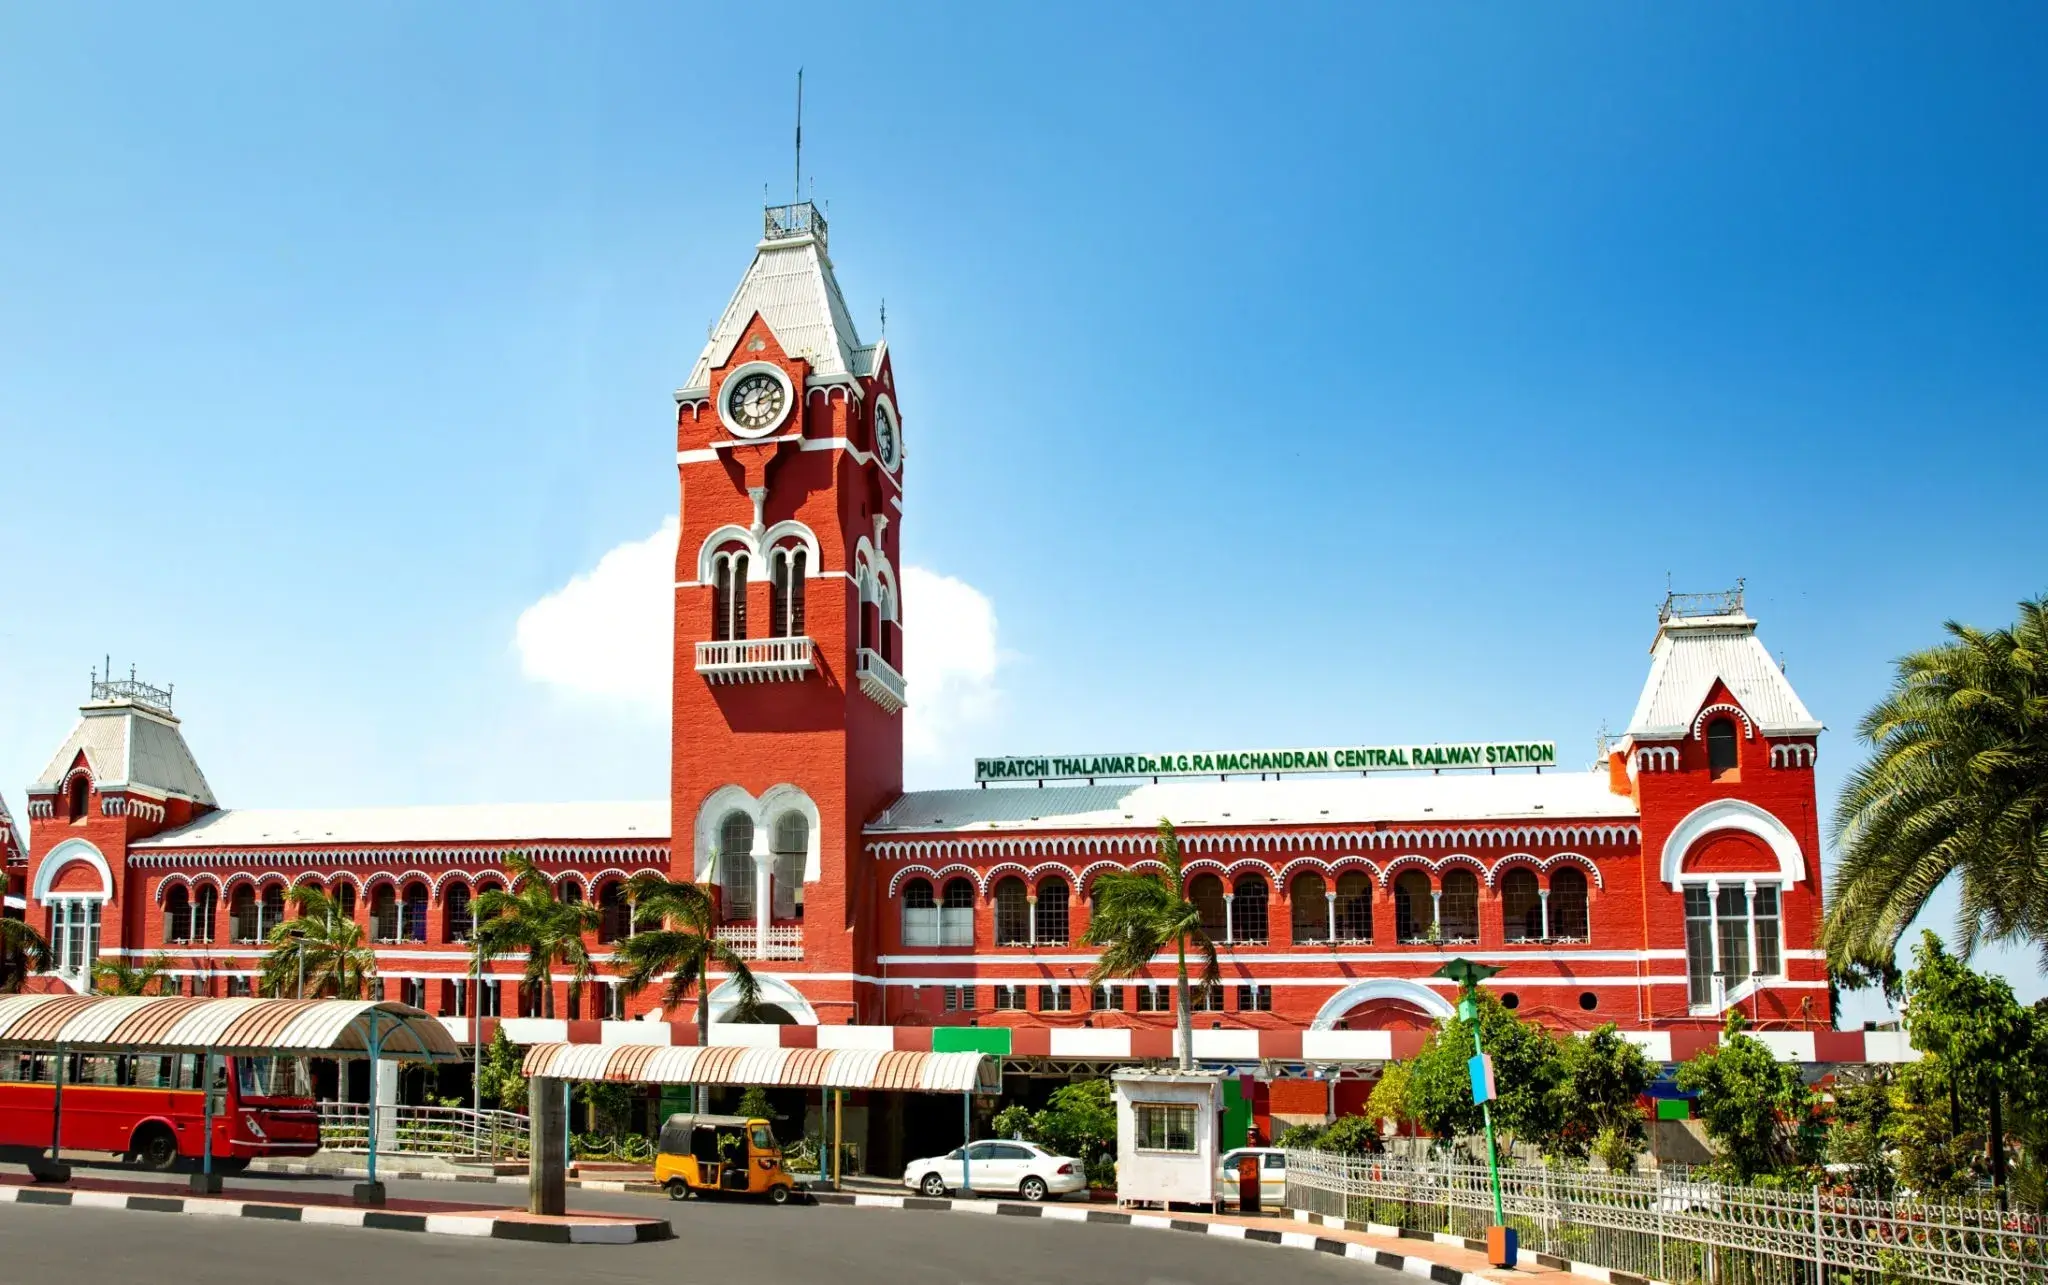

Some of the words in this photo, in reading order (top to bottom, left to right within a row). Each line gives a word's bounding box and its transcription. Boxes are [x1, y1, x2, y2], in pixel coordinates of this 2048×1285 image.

[977, 758, 1049, 777] PURATCHI
[1053, 756, 1135, 775] THALAIVAR
[1334, 749, 1408, 767] CENTRAL
[1412, 747, 1482, 764] RAILWAY
[1486, 744, 1554, 763] STATION
